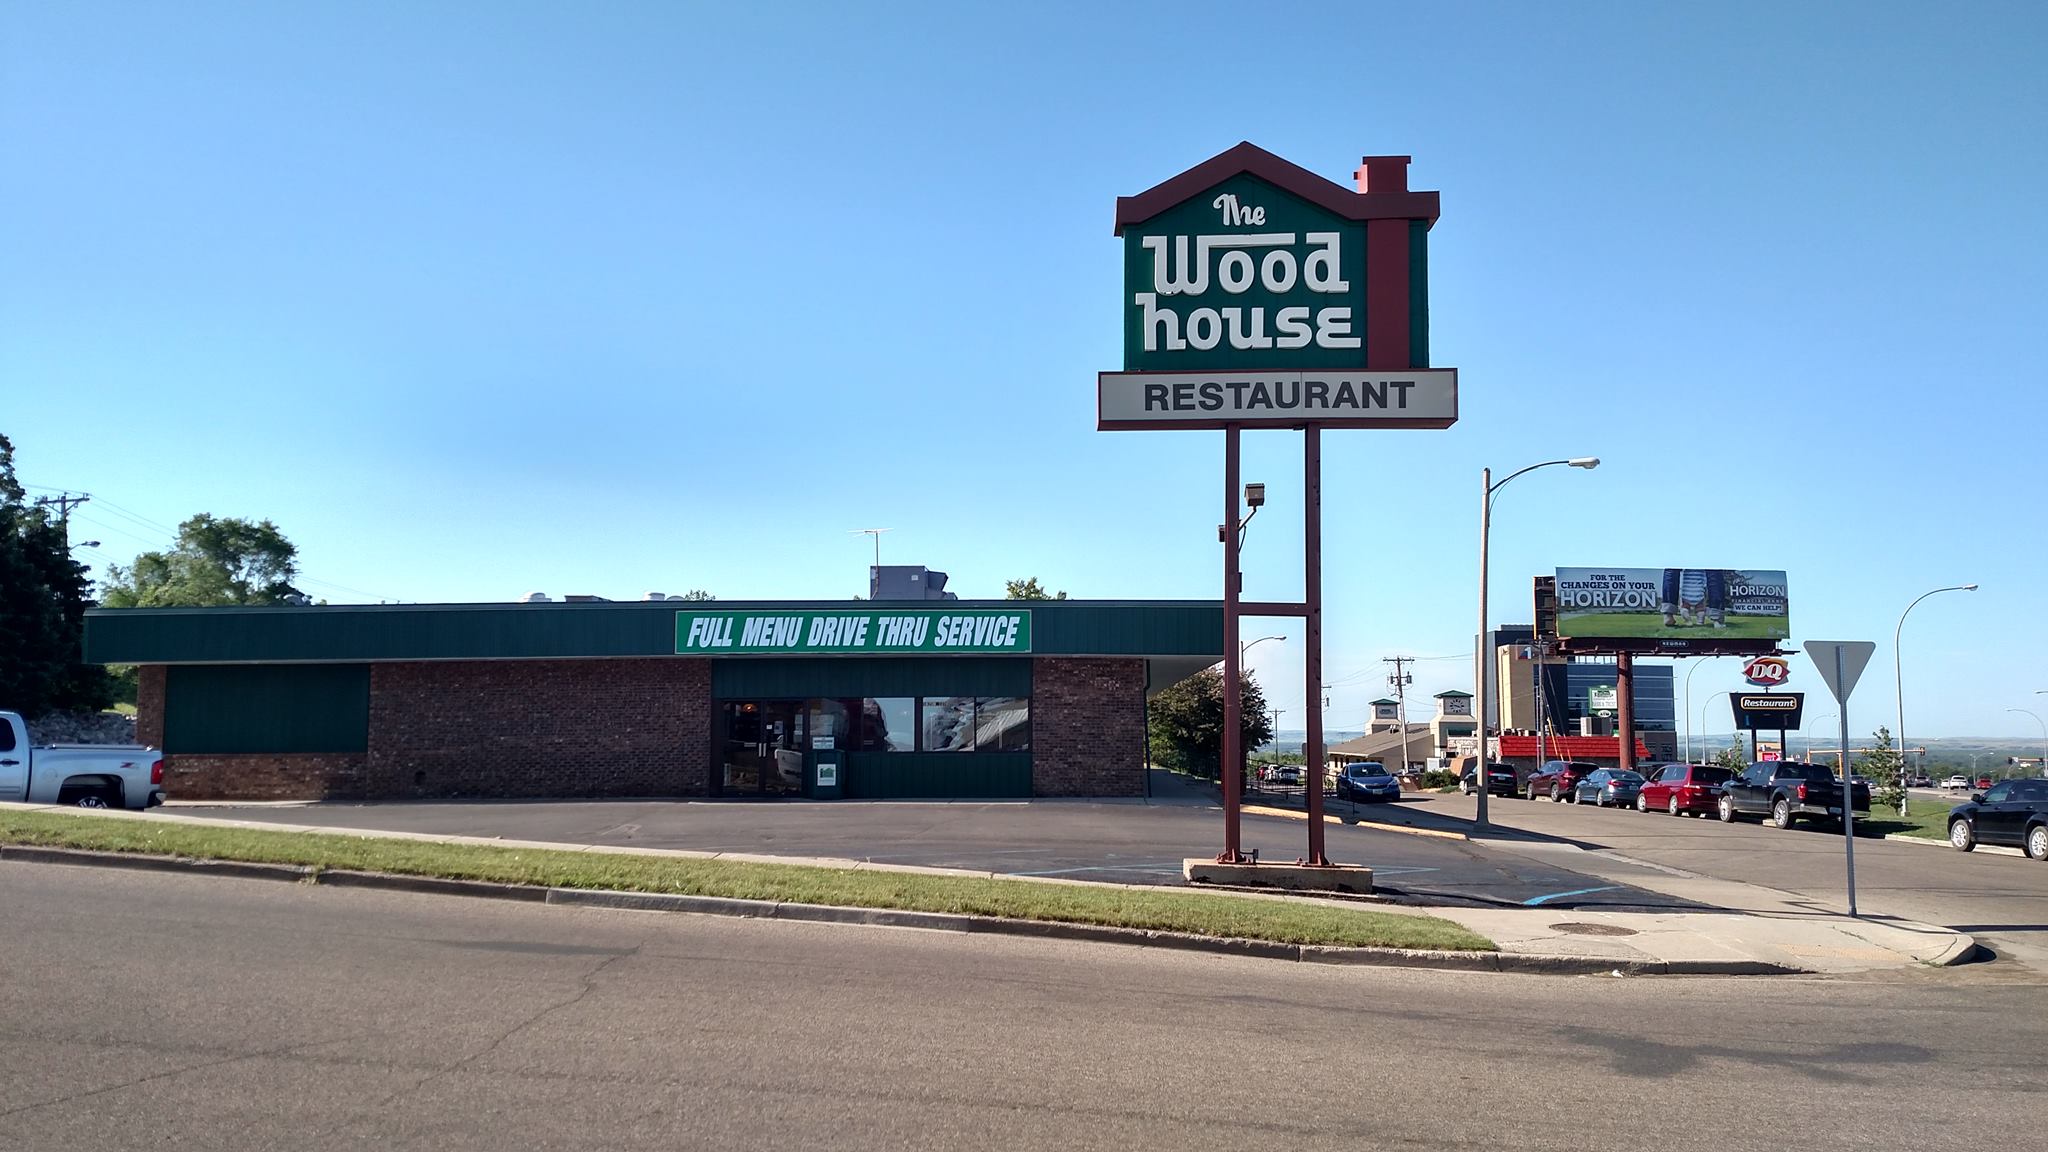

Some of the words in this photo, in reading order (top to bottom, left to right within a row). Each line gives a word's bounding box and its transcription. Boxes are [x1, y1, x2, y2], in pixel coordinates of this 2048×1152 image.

[1213, 193, 1266, 226] The
[1142, 232, 1349, 295] Wood
[1144, 381, 1415, 411] RESTAURANT
[1560, 581, 1609, 589] CHANGES
[1611, 581, 1626, 589] ON
[1628, 582, 1655, 590] YOUR
[1730, 585, 1785, 596] HORIZON
[1560, 590, 1657, 607] HORIZON
[686, 617, 734, 648] FULL
[739, 617, 804, 648] MENU
[807, 616, 869, 647] DRIVE
[875, 616, 931, 647] THRU
[934, 616, 1021, 647] SERVICE
[1752, 663, 1783, 680] DQ
[1744, 699, 1794, 707] Restaurant
